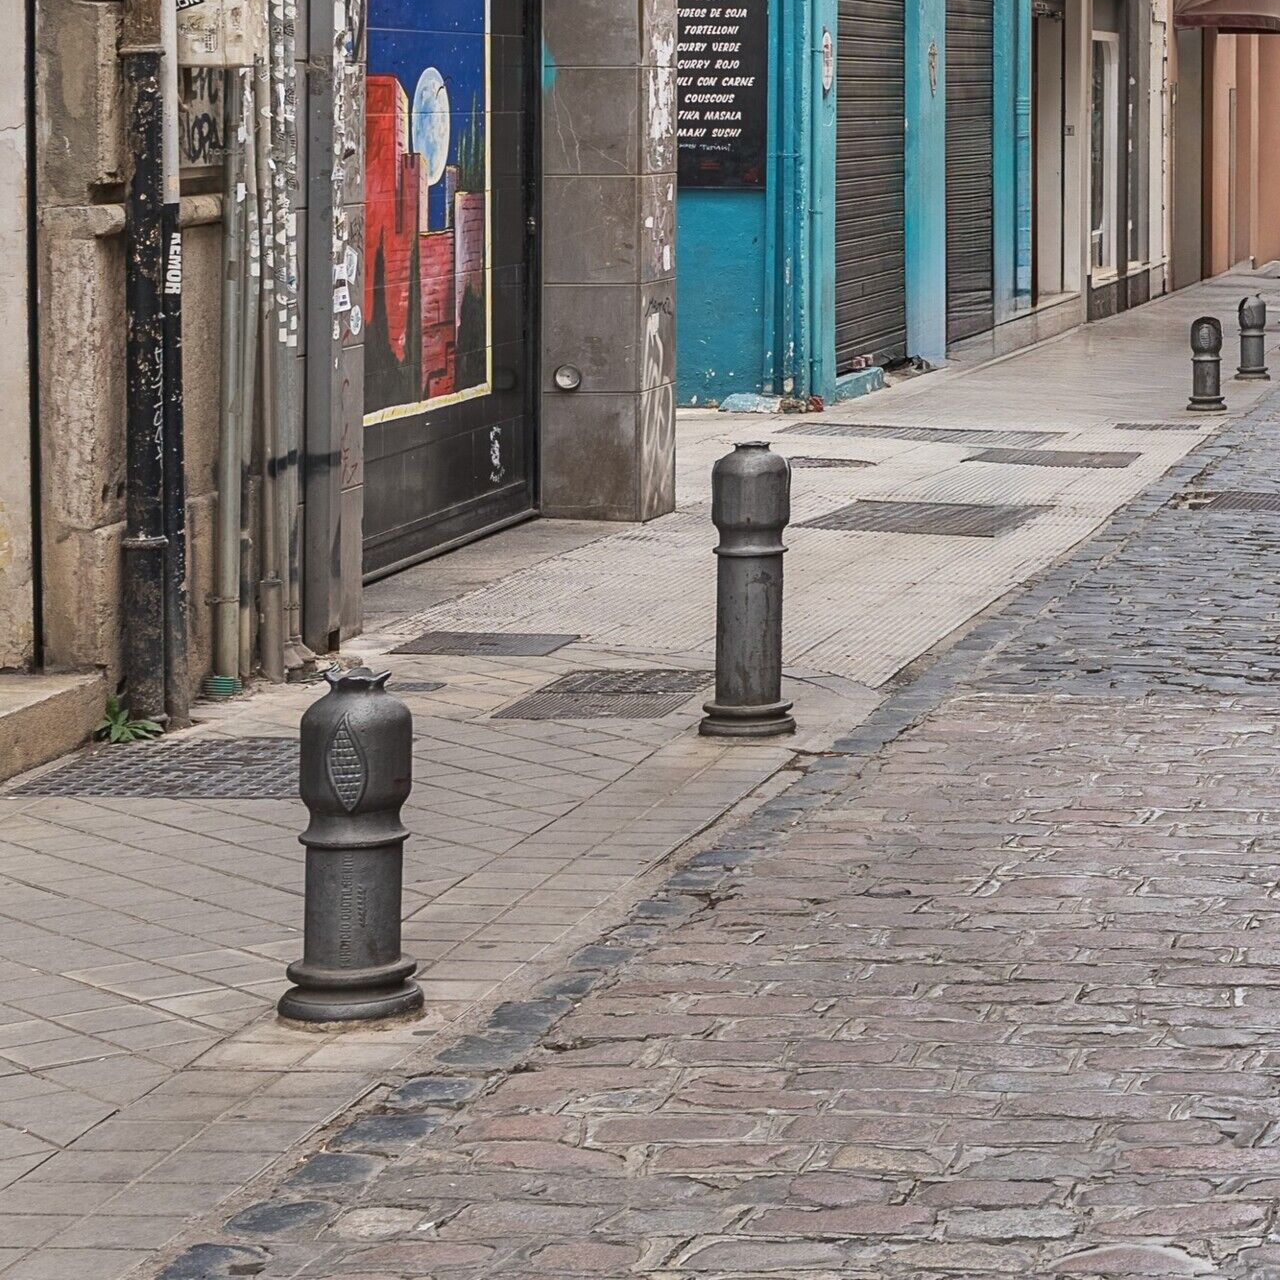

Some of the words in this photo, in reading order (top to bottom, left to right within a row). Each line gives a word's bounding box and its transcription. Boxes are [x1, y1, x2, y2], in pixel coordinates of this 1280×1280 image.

[709, 8, 722, 18] DE
[725, 8, 748, 18] SOJA
[684, 25, 740, 35] TORTELLONI
[677, 42, 707, 52] CURRY
[712, 42, 742, 52] VERDE
[677, 59, 710, 69] CURRY
[714, 59, 740, 69] ROJO
[697, 77, 718, 87] CON
[721, 77, 755, 87] CARNE
[684, 93, 735, 103] COUSCOUS
[677, 110, 700, 120] TIKA
[704, 110, 742, 120] MASALA
[677, 128, 707, 137] MAKI
[711, 128, 742, 137] SUSHI
